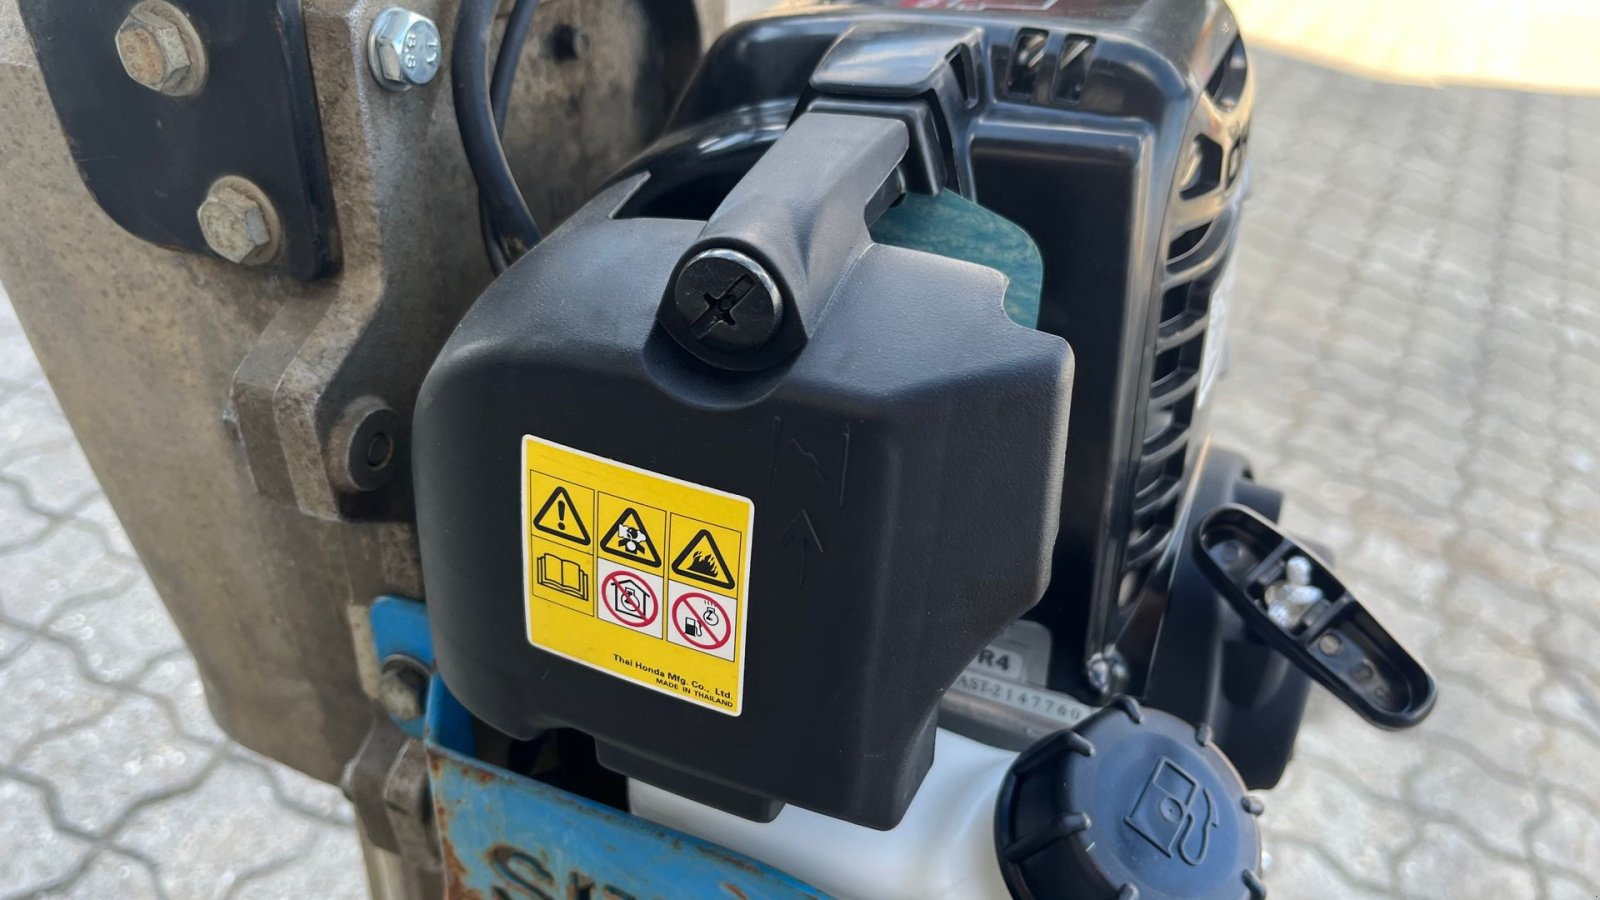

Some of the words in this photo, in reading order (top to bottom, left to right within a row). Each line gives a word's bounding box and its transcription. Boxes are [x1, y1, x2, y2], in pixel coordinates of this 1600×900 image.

[613, 653, 633, 667] Thai
[635, 661, 665, 677] Honda
[667, 672, 689, 686] Mfg.
[715, 687, 733, 699] Ltd.
[655, 678, 679, 690] MADE
[682, 686, 691, 694] IN
[694, 690, 733, 708] THAILAND
